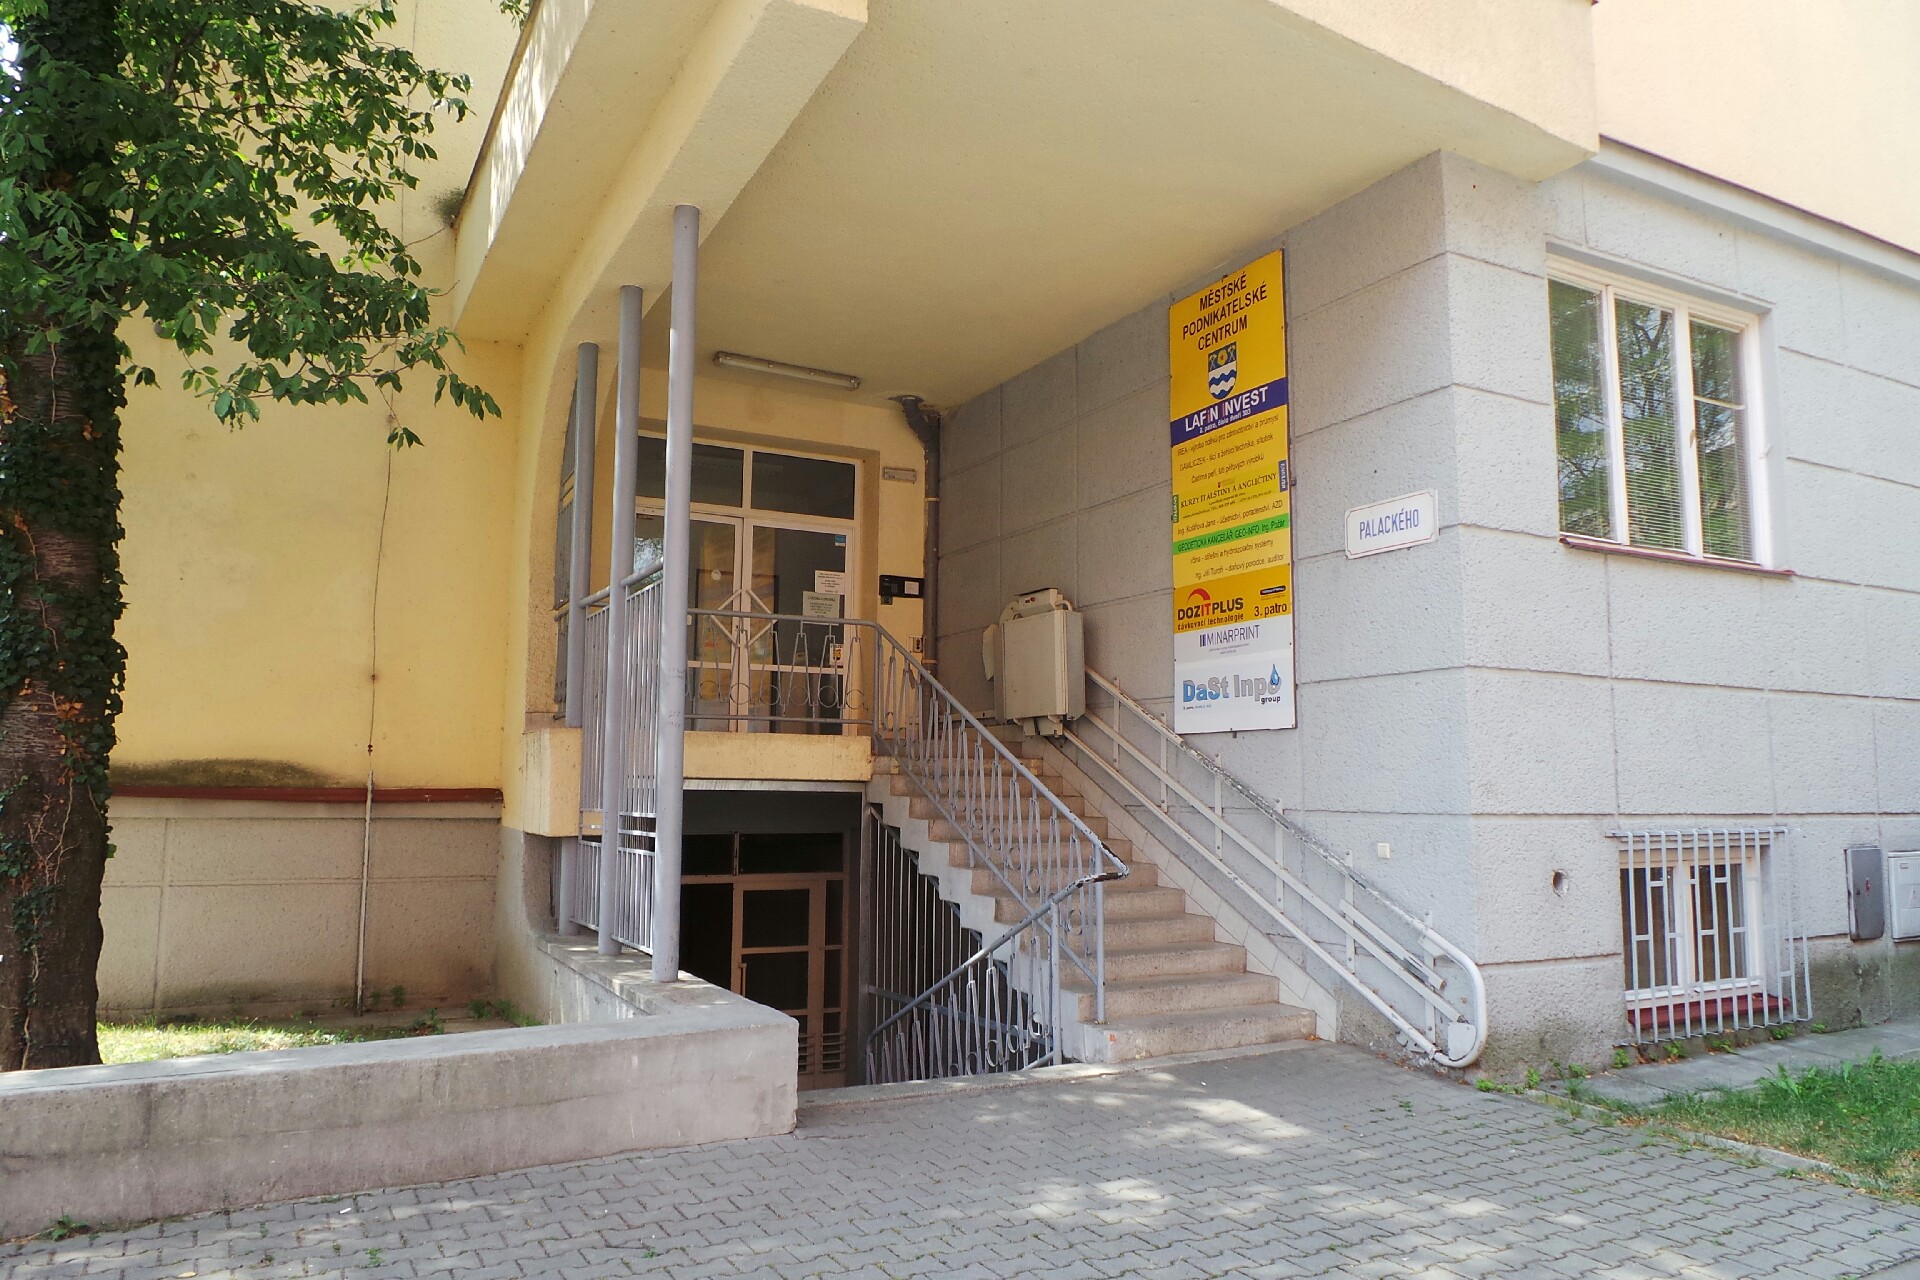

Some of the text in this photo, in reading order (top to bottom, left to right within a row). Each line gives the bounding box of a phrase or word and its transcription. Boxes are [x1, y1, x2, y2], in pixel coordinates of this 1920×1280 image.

[1200, 271, 1247, 312] MĚSTSKÉ
[1182, 281, 1268, 340] PODNIKATELSKÉ
[1198, 314, 1248, 351] CENTRUM
[1181, 496, 1199, 508] KURZY
[1359, 507, 1420, 540] PALACKÉHO
[1177, 597, 1243, 621] DOZITPLUS
[1178, 612, 1244, 631] dávkovací technologie
[1254, 601, 1287, 618] 3. patro
[1183, 675, 1229, 702] DaSt
[1261, 695, 1281, 705] group
